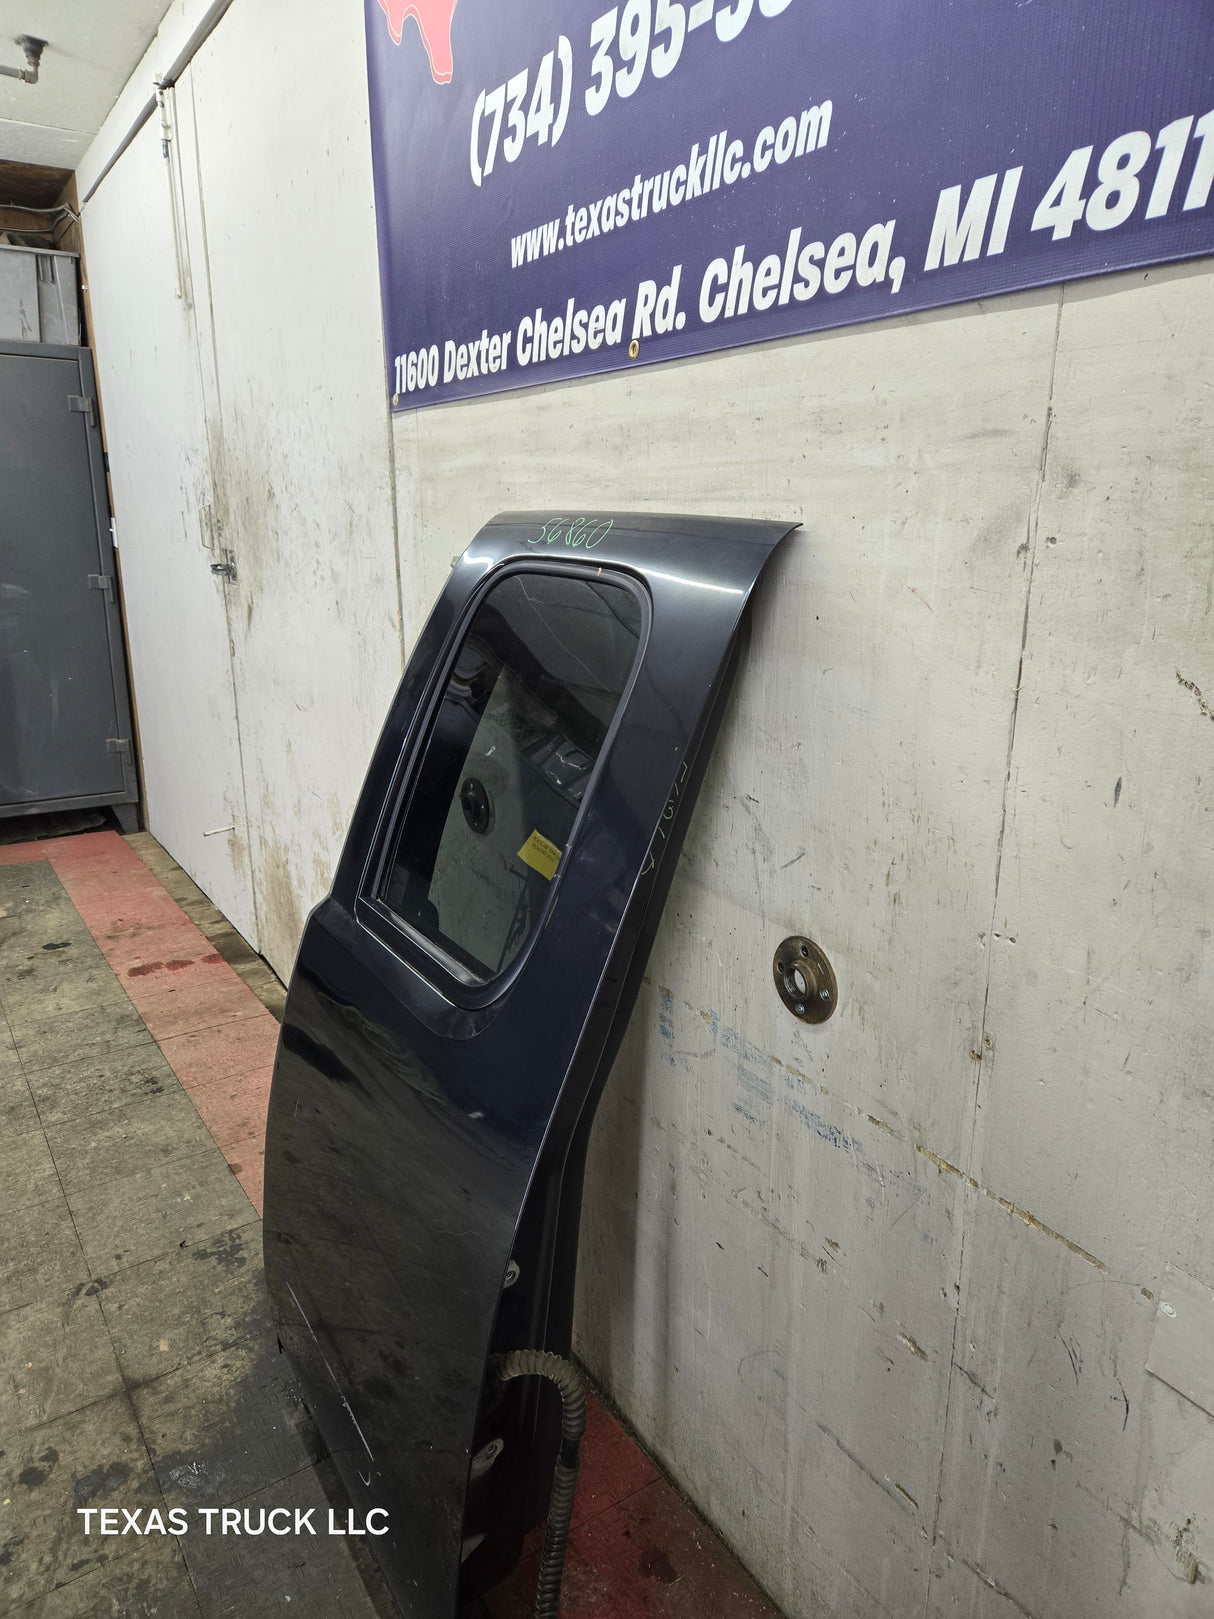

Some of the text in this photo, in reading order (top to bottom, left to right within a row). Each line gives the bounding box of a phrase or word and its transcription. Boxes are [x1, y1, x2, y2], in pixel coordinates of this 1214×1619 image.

[470, 0, 793, 187] (734) 395-
[510, 99, 834, 269] www.texastruckllc.com
[394, 344, 440, 395] 11600
[443, 329, 512, 384] Dexter
[516, 297, 627, 367] Chelsea
[631, 263, 687, 340] Rd.
[698, 218, 906, 324] Chelsea,
[923, 165, 1024, 272] MI
